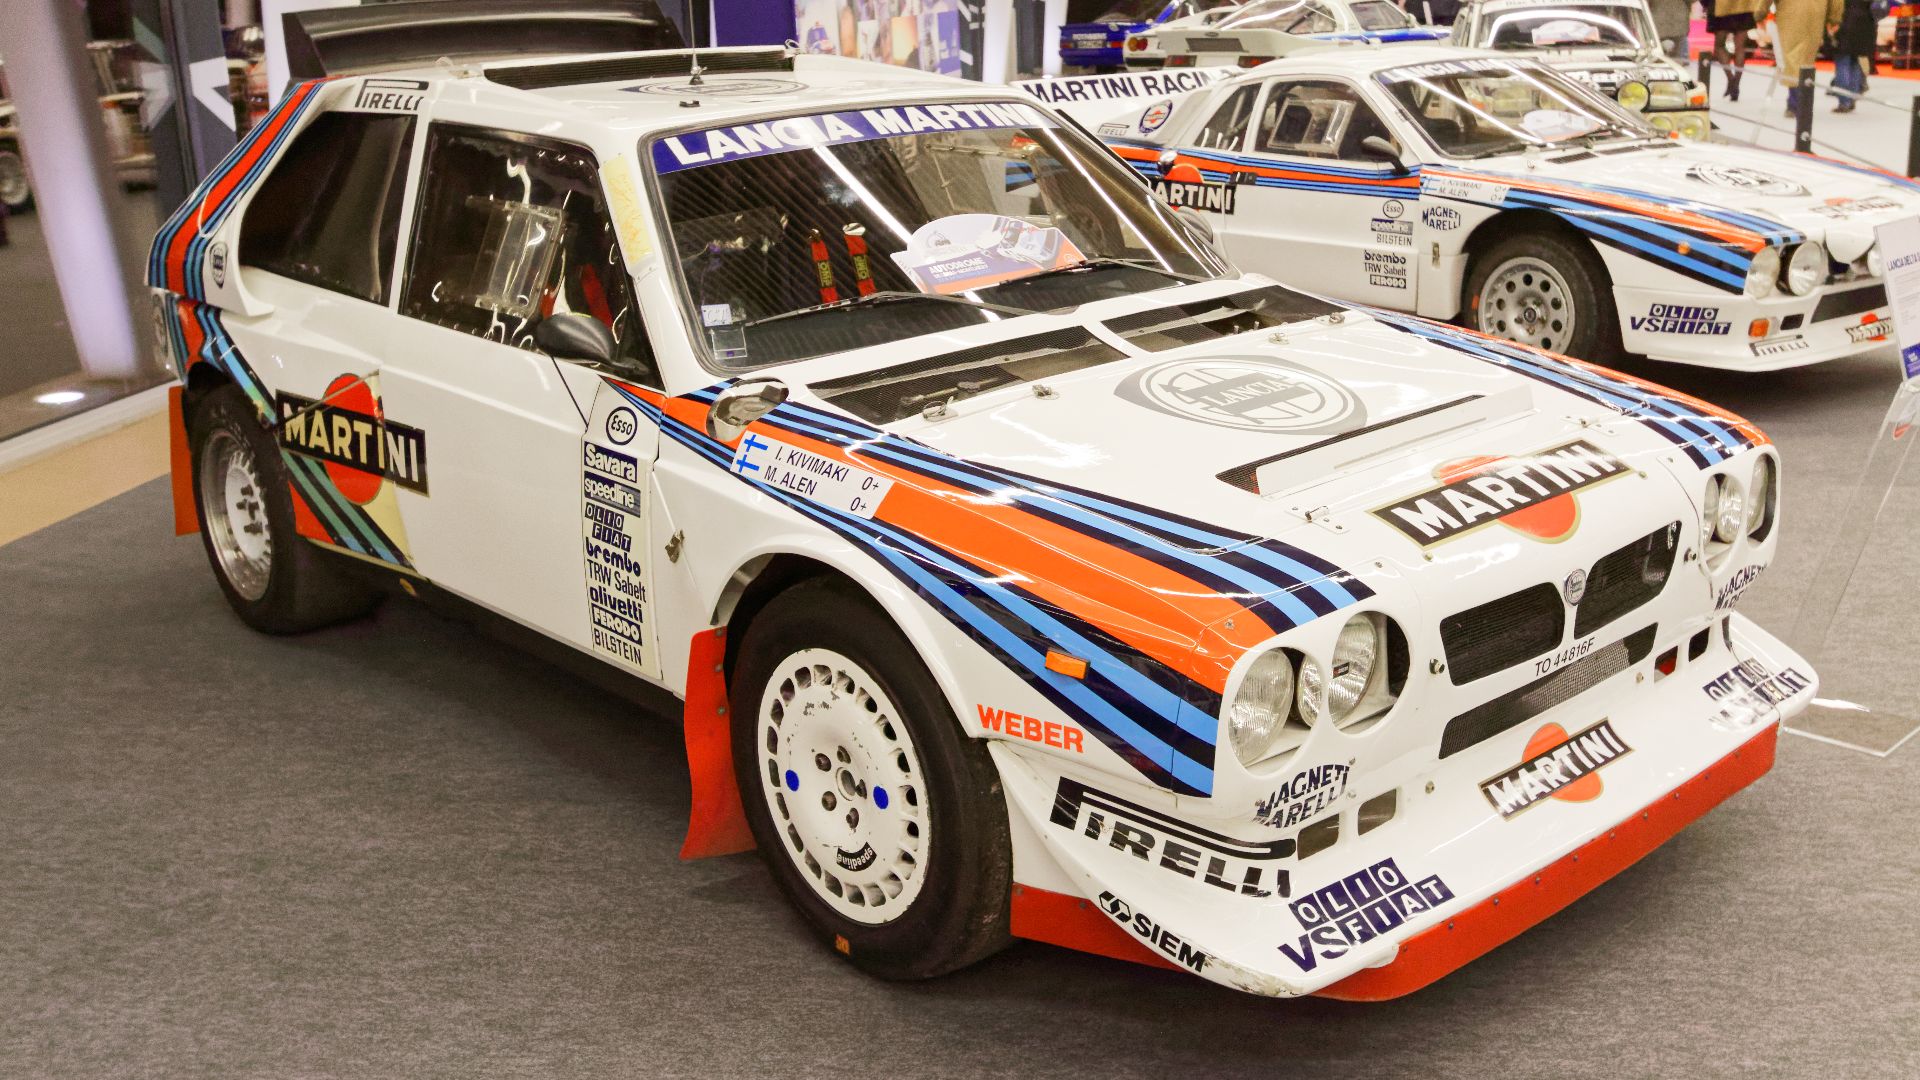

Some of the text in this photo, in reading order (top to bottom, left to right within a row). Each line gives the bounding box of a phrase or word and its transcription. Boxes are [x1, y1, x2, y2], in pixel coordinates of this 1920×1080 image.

[355, 79, 429, 110] PIRELLI
[1023, 77, 1139, 103] MARTINI
[665, 113, 862, 165] LANCIA
[1150, 184, 1232, 210] ARTINI
[1364, 250, 1406, 264] brembo
[1376, 233, 1412, 246] BILSTEIN
[1364, 263, 1406, 276] TRW Sabelt
[1371, 276, 1405, 287] FERODO
[1650, 304, 1718, 319] OLIO
[1204, 380, 1289, 406] LANCIA
[283, 402, 419, 483] MARTINI
[585, 443, 636, 482] Savara
[775, 446, 782, 461] I.
[786, 449, 850, 483] KIVIMAKI
[584, 477, 635, 509] speedline
[764, 465, 777, 483] M.
[780, 471, 818, 496] ALEN
[1391, 444, 1619, 538] MARTINI
[586, 502, 624, 530] OLIO
[592, 522, 631, 550] FIAT
[585, 536, 642, 577] brembo
[587, 558, 646, 603] TRW Sabelt
[589, 585, 643, 624] olivetti
[593, 610, 642, 644] FERODO
[594, 627, 642, 666] BILSTEIN
[1535, 637, 1595, 676] TO 44816F
[977, 704, 1084, 753] WEBER
[1487, 724, 1625, 814] MARTINI
[1050, 776, 1297, 899] PIRELLI
[836, 847, 873, 870] speedline
[1289, 857, 1409, 931] OLIO
[1132, 912, 1208, 973] SIEM
